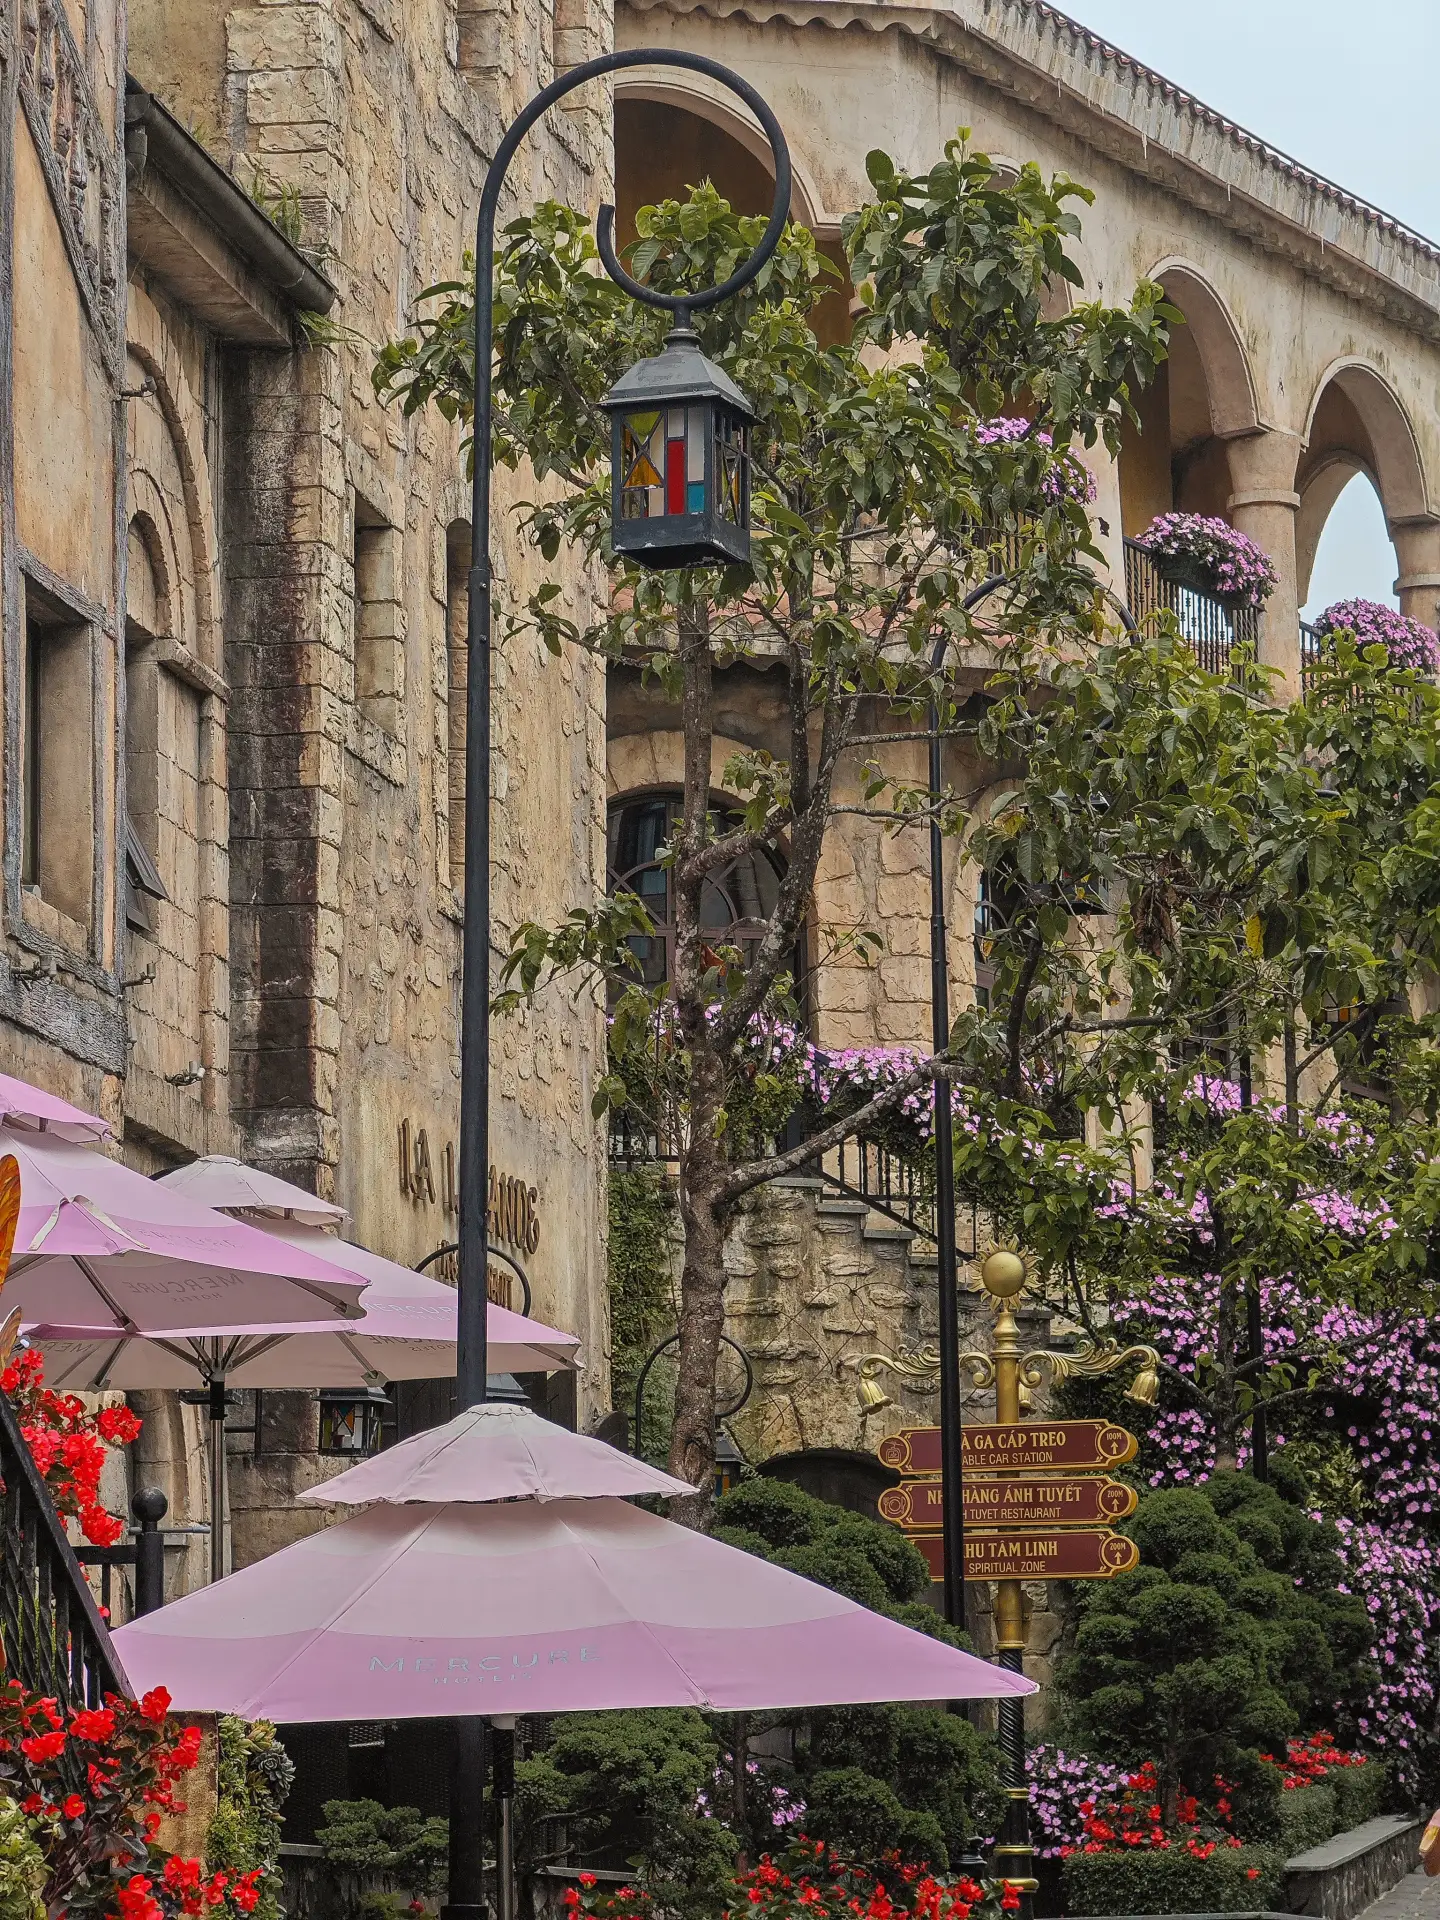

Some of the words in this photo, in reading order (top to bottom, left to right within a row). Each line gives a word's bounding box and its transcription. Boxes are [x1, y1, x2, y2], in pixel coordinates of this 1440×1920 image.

[363, 1301, 458, 1314] MERCUR
[974, 1434, 993, 1450] GA
[997, 1431, 1027, 1449] CÁP
[1030, 1431, 1066, 1447] TREO
[1106, 1432, 1122, 1440] 100M
[962, 1454, 986, 1466] ABLE
[989, 1453, 1009, 1464] CAR
[1012, 1451, 1053, 1464] STATION
[963, 1485, 999, 1504] HÀNG
[1003, 1484, 1033, 1503] ÁNH
[1036, 1482, 1082, 1502] TUYẾT
[1107, 1490, 1123, 1498] 200M
[970, 1508, 998, 1520] TUYET
[1001, 1507, 1061, 1519] RESTAURANT
[988, 1540, 1021, 1558] TÂM
[1025, 1541, 1058, 1557] LINH
[1110, 1542, 1126, 1550] 200M
[968, 1562, 1018, 1574] SPIRITUAL
[1020, 1561, 1046, 1572] ZONE
[368, 1644, 602, 1673] MERCURE
